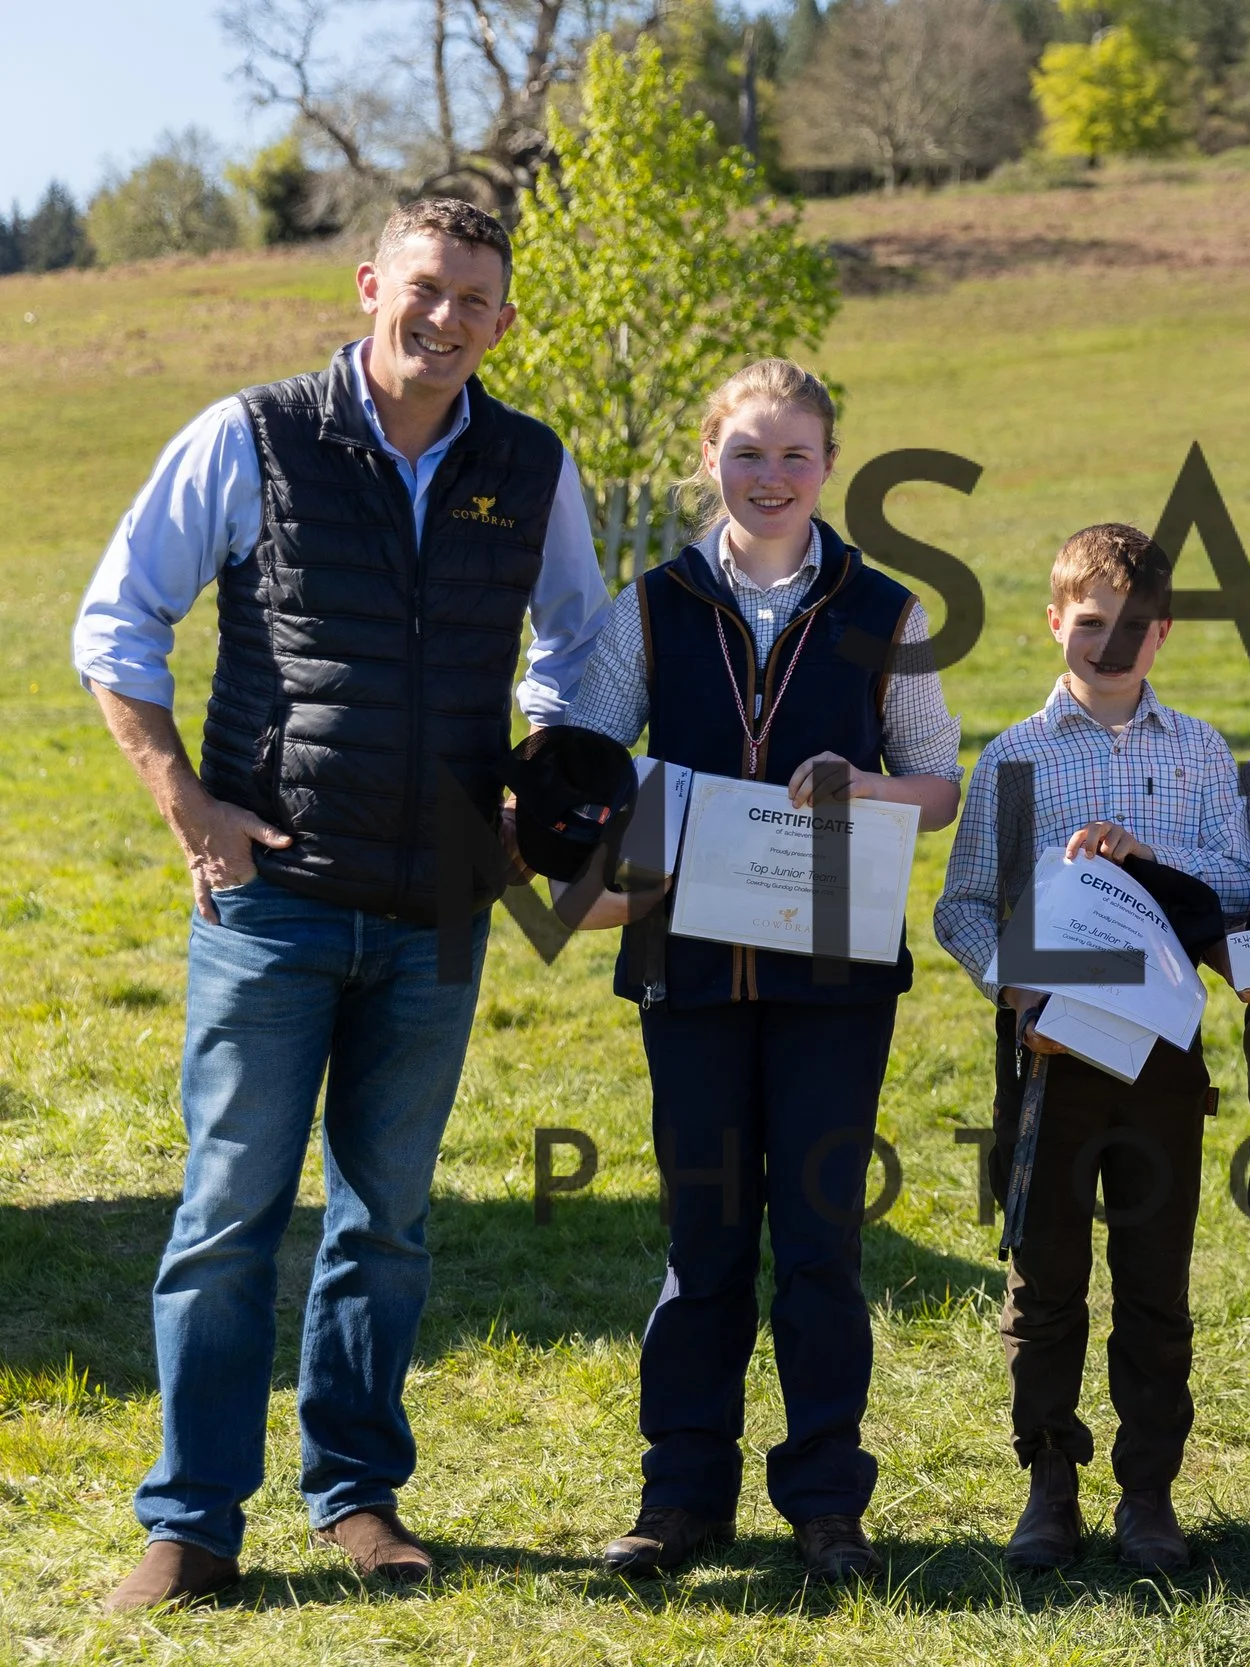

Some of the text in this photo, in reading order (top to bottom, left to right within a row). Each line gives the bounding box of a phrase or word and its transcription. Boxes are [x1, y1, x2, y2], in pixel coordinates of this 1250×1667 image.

[452, 509, 515, 528] COWDRAY
[749, 808, 854, 835] CERTIFICATE
[769, 847, 790, 858] Proudly
[749, 861, 837, 883] Top Junior Team
[746, 879, 771, 890] Cowdray
[771, 882, 794, 893] Gundog
[794, 885, 820, 896] Challenge
[1080, 873, 1169, 933] CERTIFICATE
[753, 918, 814, 934] COWDRA
[1069, 918, 1087, 932] Top
[1088, 927, 1121, 945] Junior
[1124, 940, 1149, 960] Team
